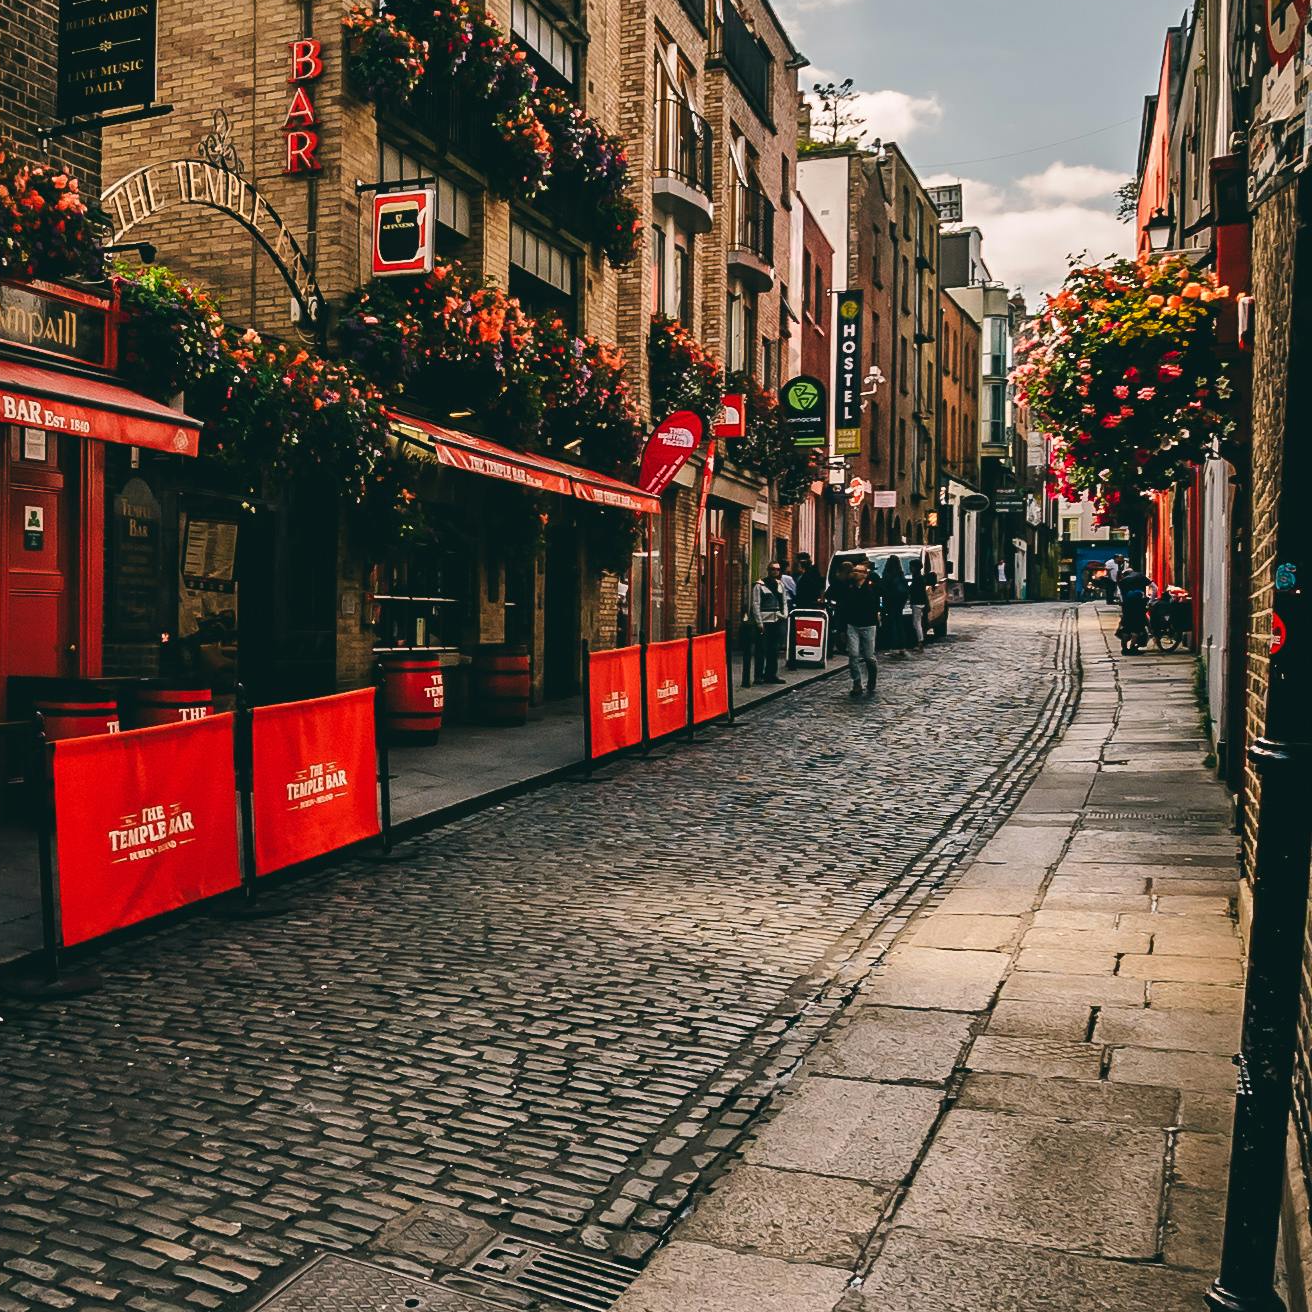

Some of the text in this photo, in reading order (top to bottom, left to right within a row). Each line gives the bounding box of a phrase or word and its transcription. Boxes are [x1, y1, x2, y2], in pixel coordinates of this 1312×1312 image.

[98, 4, 149, 24] GARDEN
[68, 59, 144, 83] LIVE MUSIC
[85, 79, 126, 96] DAILY
[278, 39, 324, 174] BAR
[108, 167, 166, 232] THE
[174, 161, 267, 232] TEMPLE
[842, 324, 856, 419] HOSTEL
[3, 395, 42, 425] BAR
[287, 769, 347, 800] TEMPLE BAR
[310, 763, 323, 778] THE
[142, 805, 166, 823] THE
[109, 811, 194, 851] TEMPLE BAR
